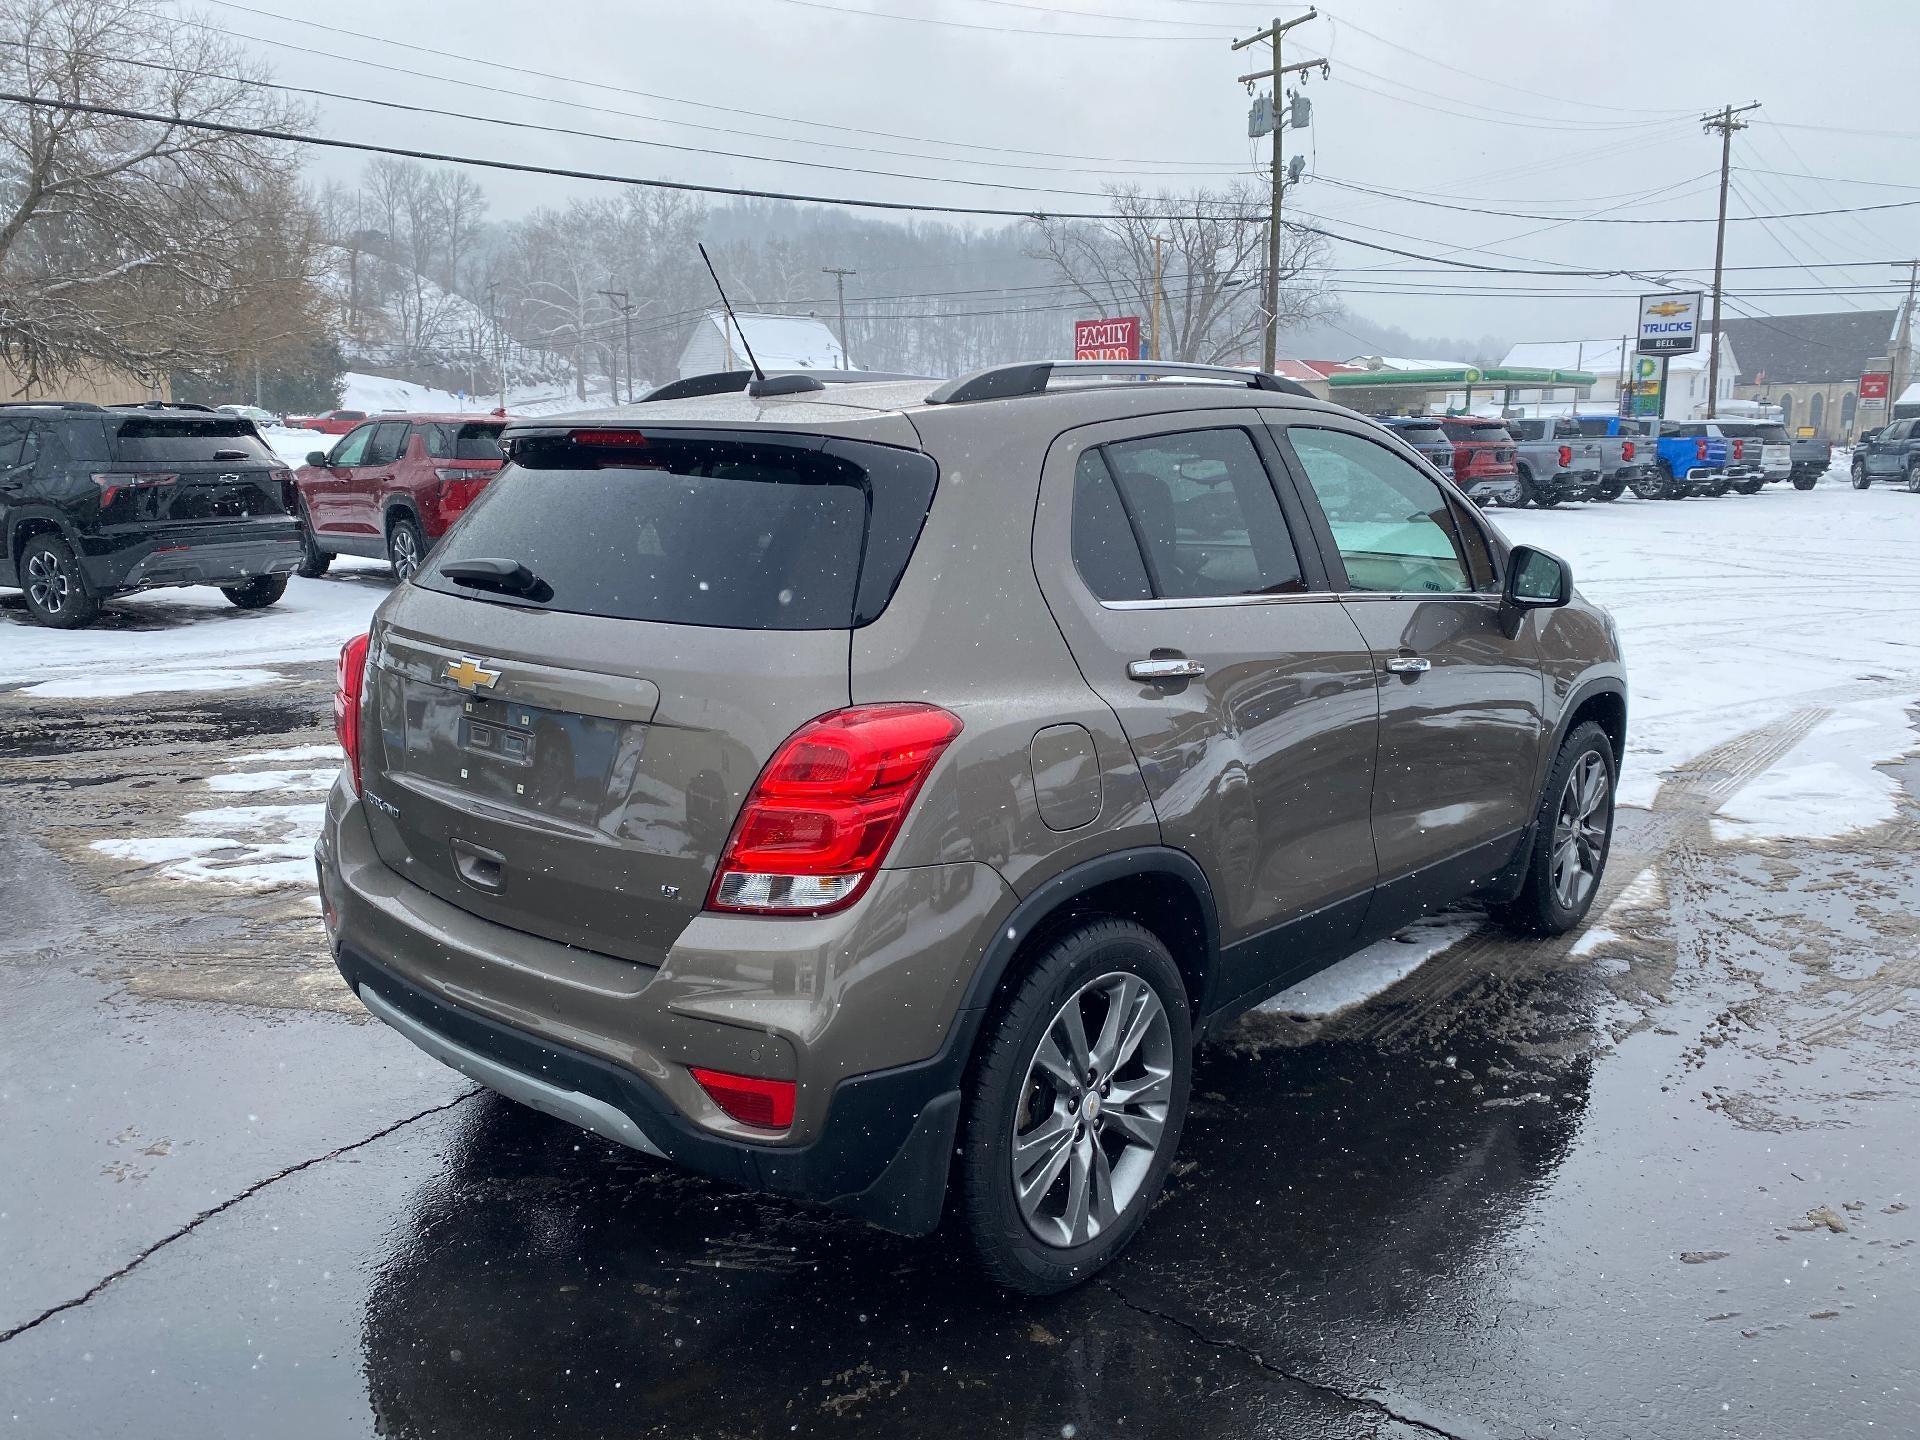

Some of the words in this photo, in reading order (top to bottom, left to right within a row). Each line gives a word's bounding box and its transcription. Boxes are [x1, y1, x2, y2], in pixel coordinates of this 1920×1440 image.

[1642, 321, 1692, 333] TRUCKS
[1077, 323, 1131, 346] FAMILY
[1656, 339, 1676, 347] BELL
